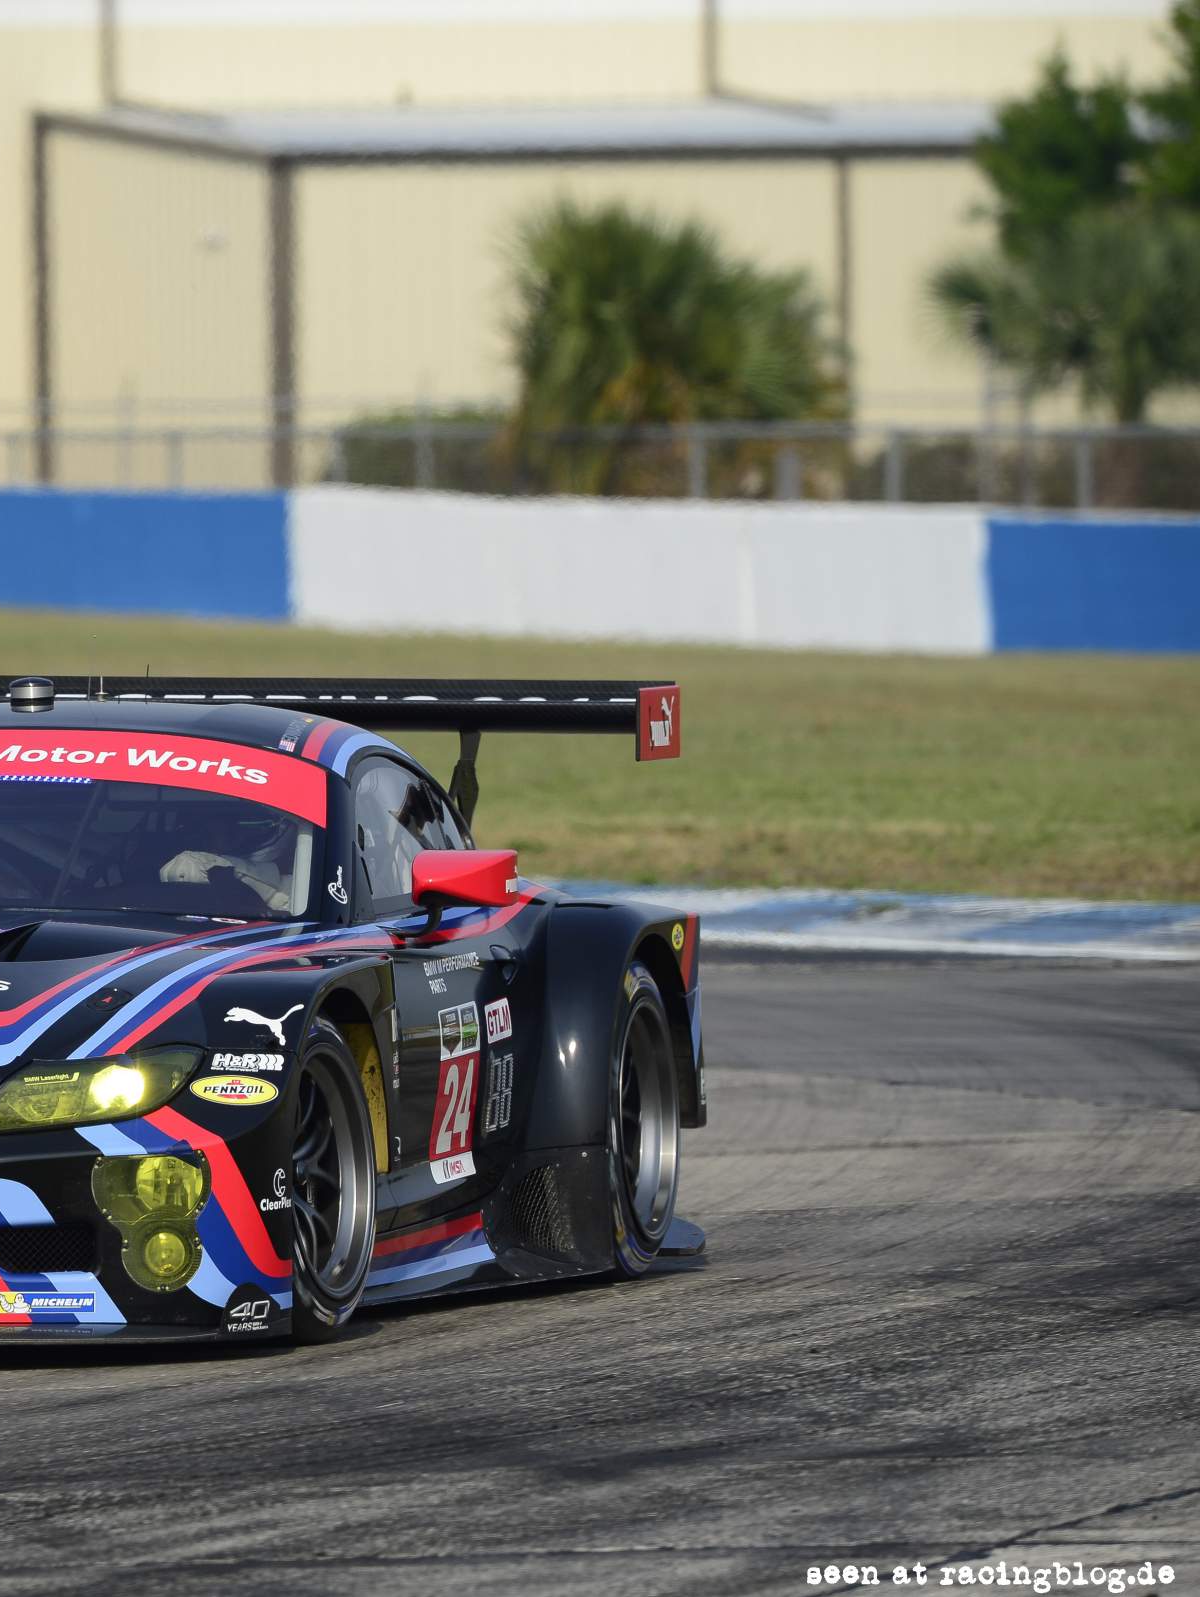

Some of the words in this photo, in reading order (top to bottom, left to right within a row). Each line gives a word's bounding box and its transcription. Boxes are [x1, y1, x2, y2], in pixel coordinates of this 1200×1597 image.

[126, 748, 270, 785] Works
[423, 960, 438, 976] BMW
[442, 951, 480, 972] PERFORMANCE
[428, 978, 448, 994] PARTS
[487, 1005, 511, 1037] GTLM
[202, 1085, 265, 1094] PENNZOIL
[435, 1059, 475, 1155] 24
[31, 1298, 94, 1306] MICHELIN
[229, 1299, 271, 1320] 40
[227, 1321, 253, 1333] YEARS
